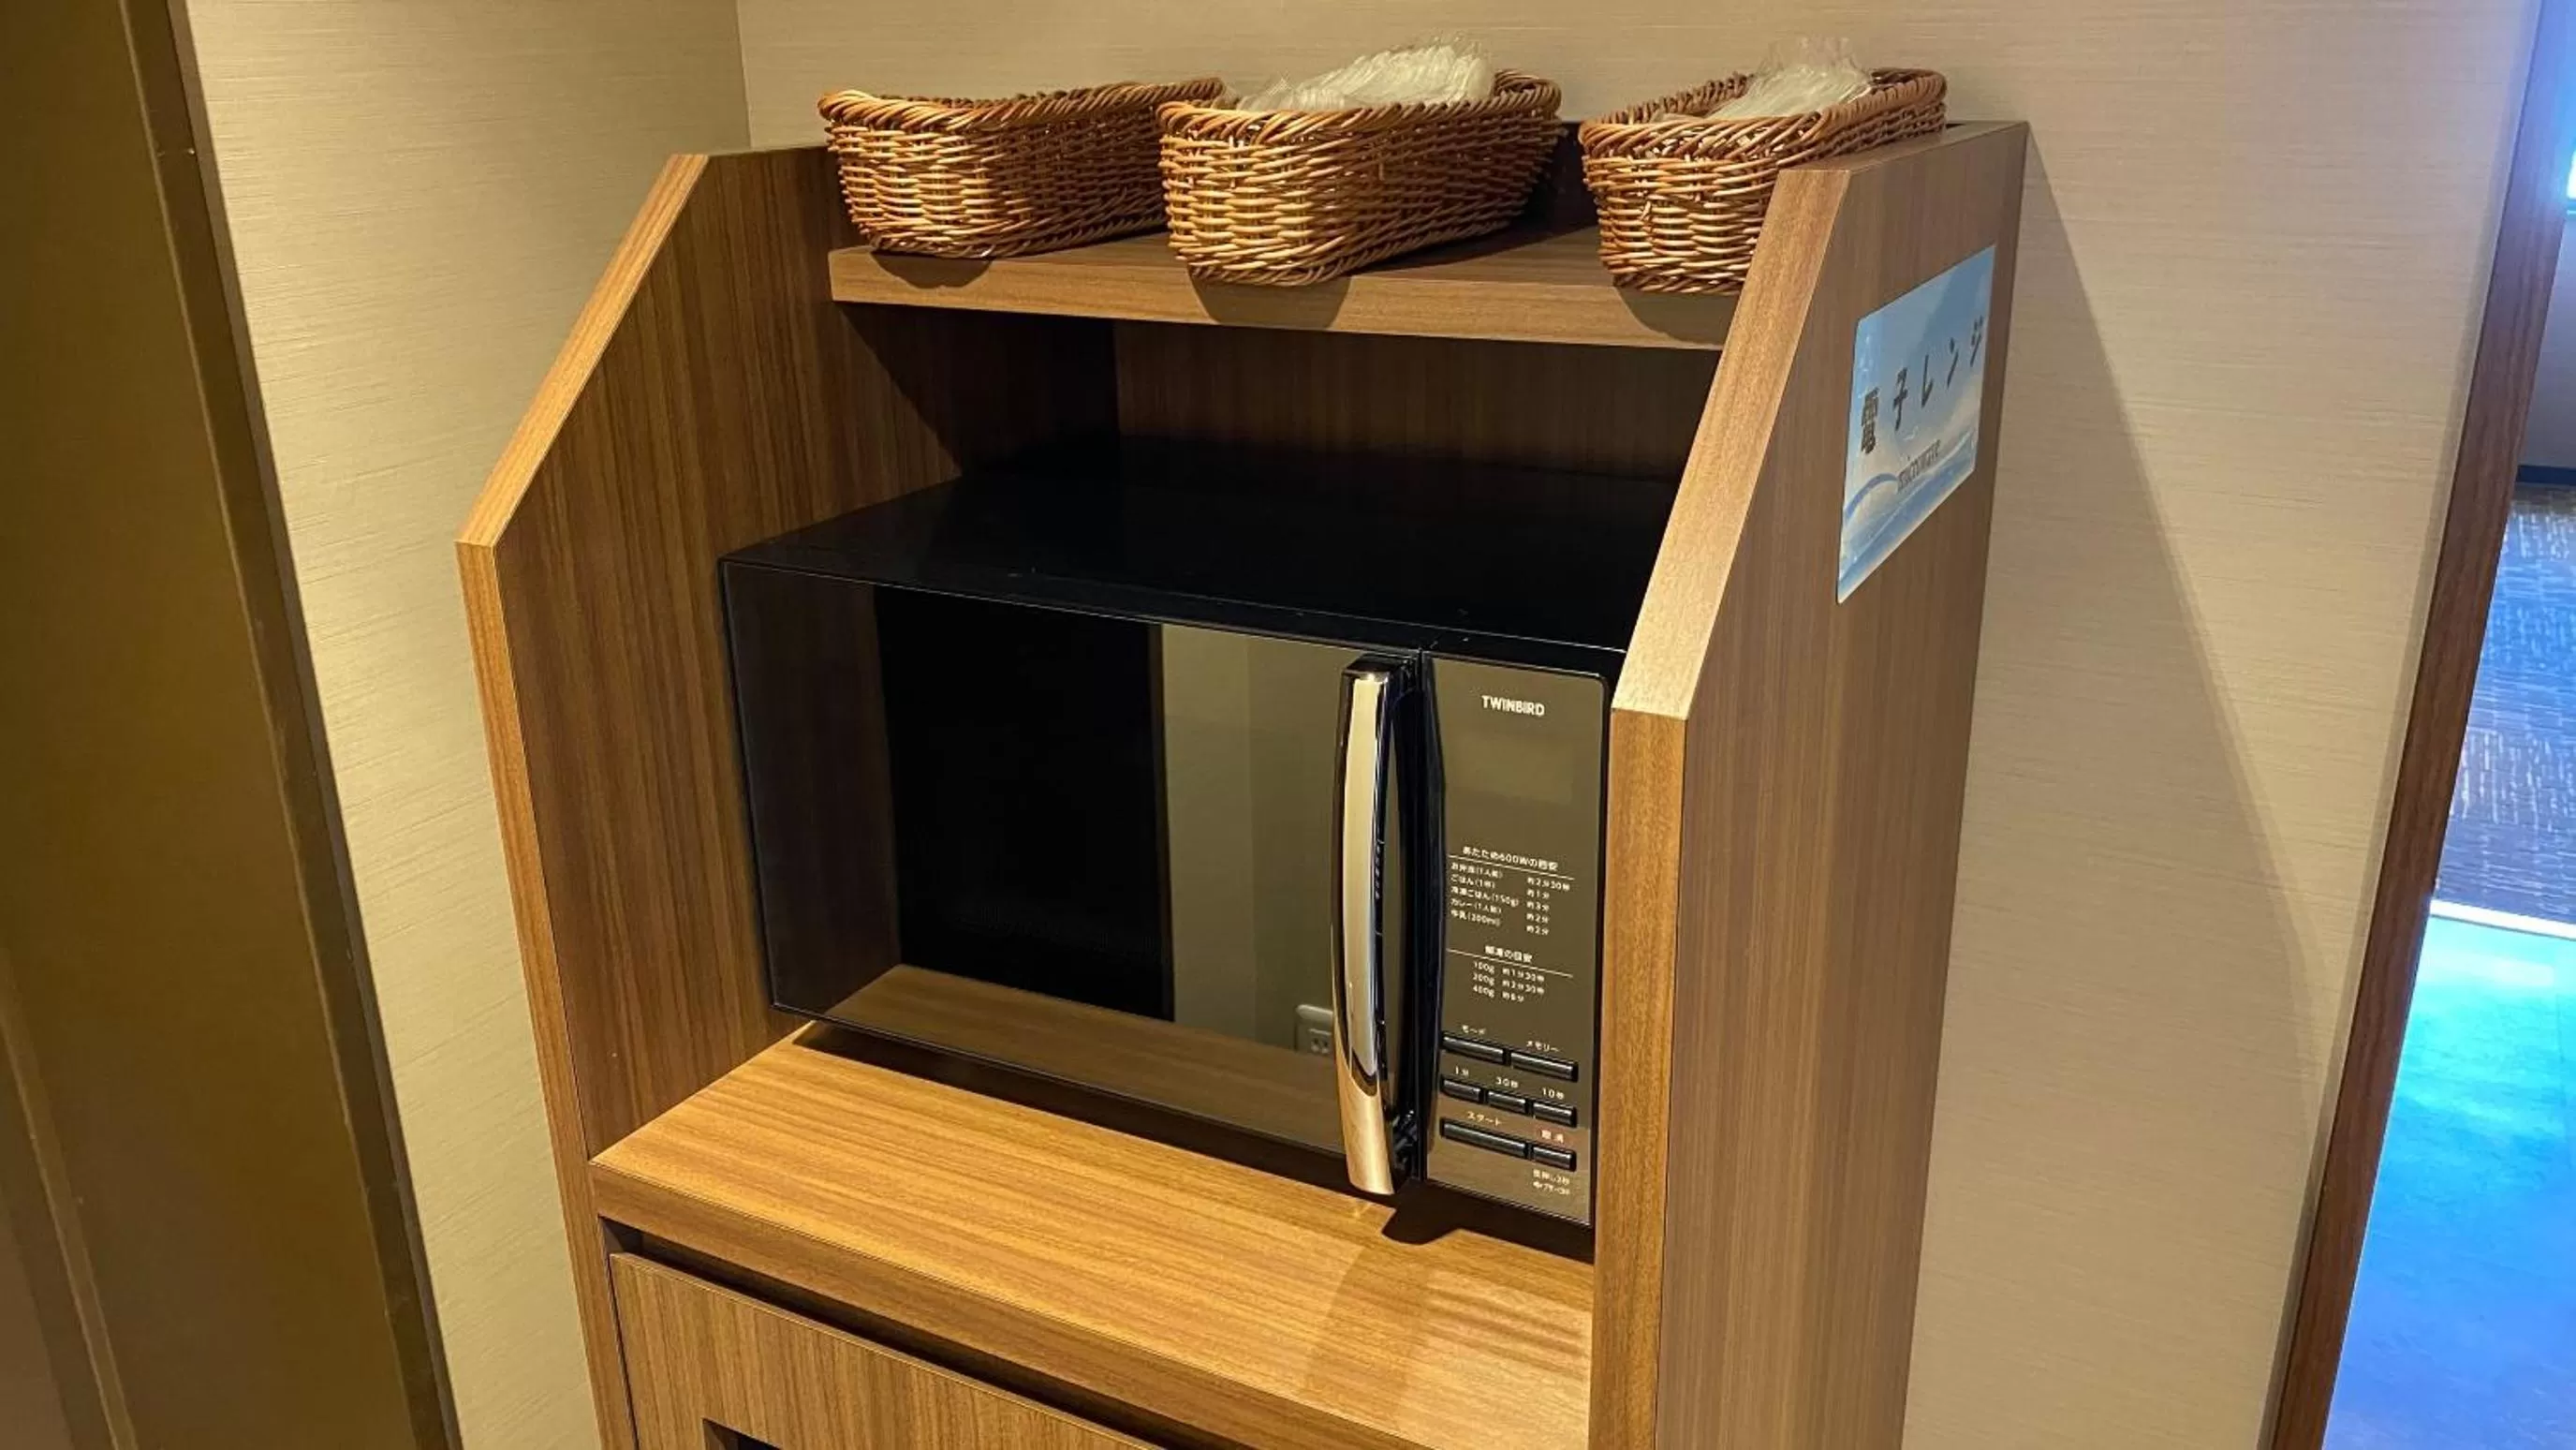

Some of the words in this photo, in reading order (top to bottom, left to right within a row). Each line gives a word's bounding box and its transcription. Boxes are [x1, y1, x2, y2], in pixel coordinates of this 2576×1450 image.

[1861, 314, 1984, 454] 電子レンジ
[1481, 694, 1545, 717] TWINBIRD
[1526, 1040, 1561, 1053] メモリー
[1467, 1111, 1502, 1127] スタート
